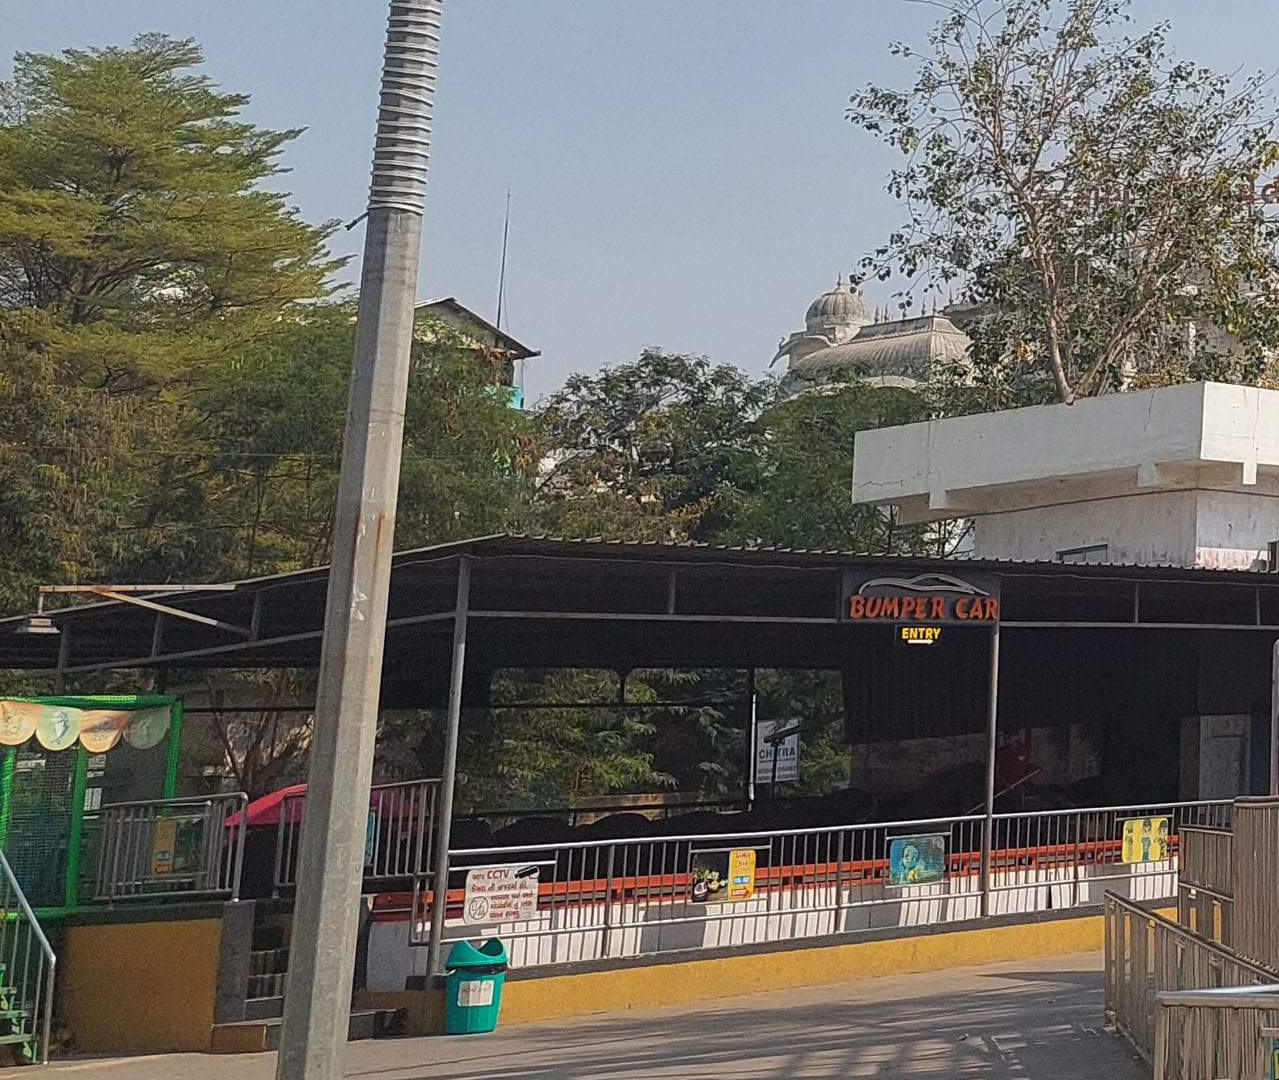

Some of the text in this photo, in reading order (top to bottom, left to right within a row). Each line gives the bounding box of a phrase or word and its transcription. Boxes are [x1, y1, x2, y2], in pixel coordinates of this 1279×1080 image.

[850, 594, 998, 619] BUMPER CAR
[901, 627, 941, 640] ENTRY
[759, 747, 795, 759] CHTRA
[487, 869, 510, 880] CCTV
